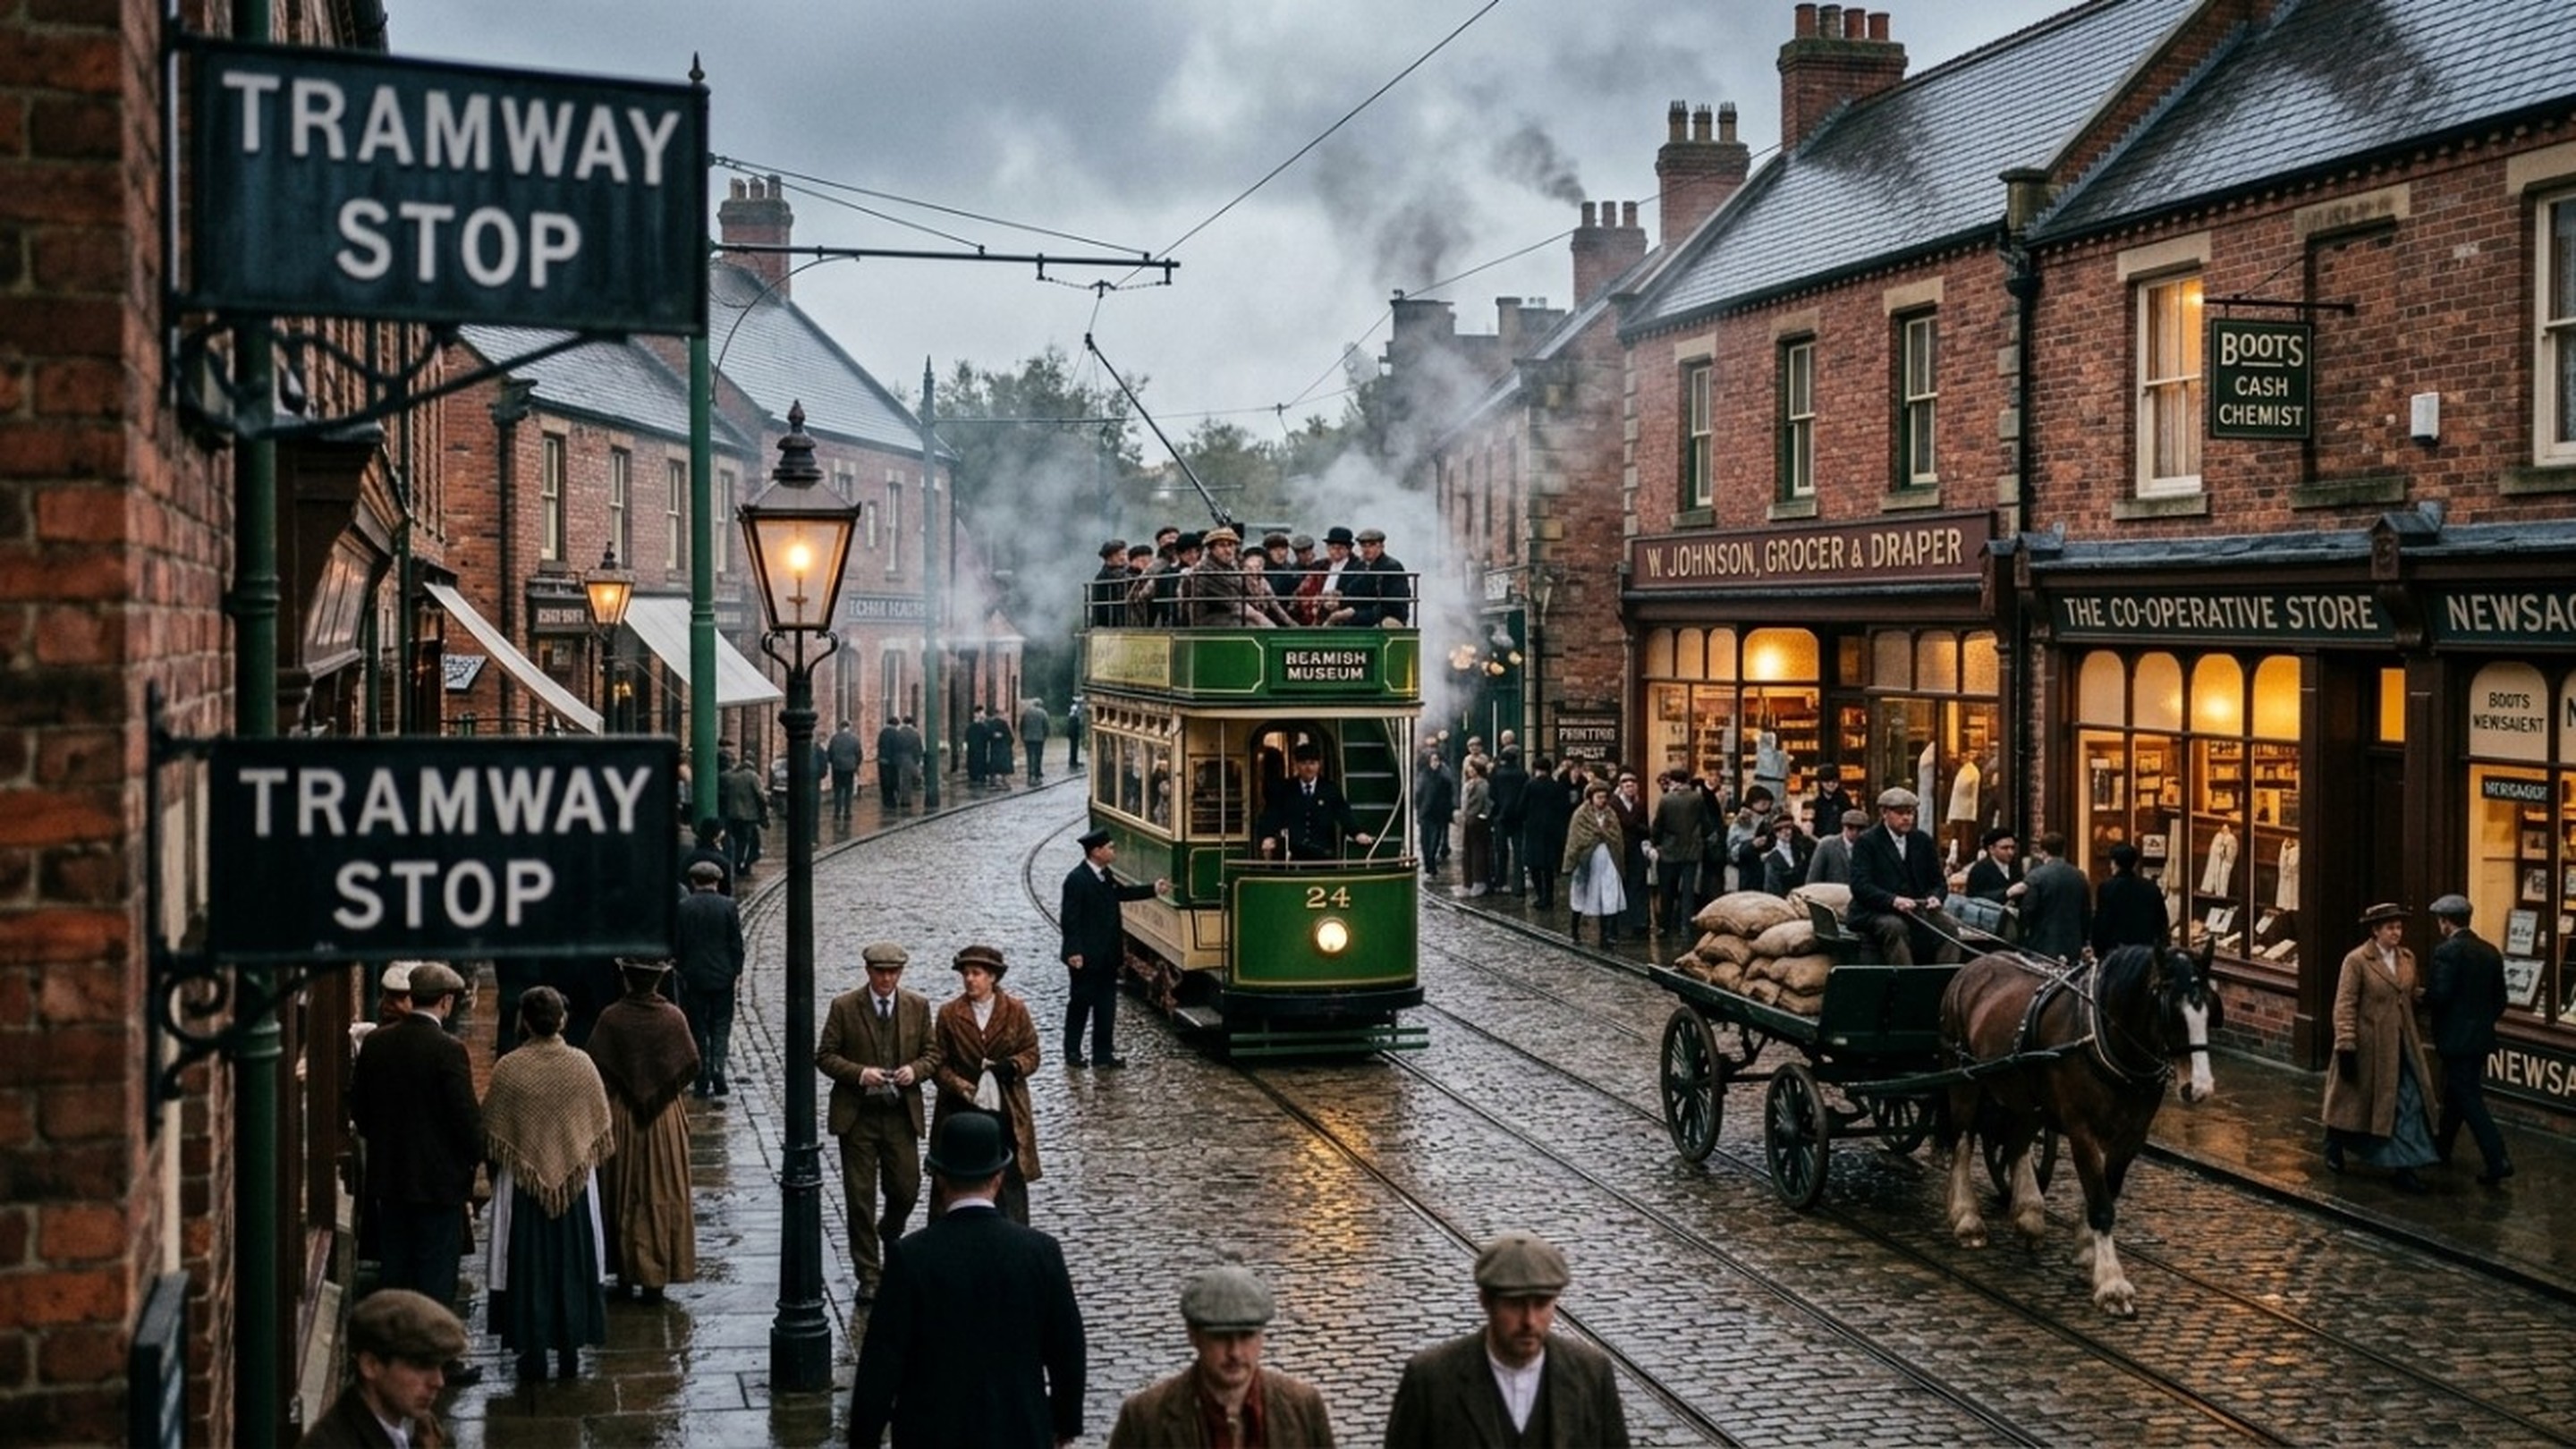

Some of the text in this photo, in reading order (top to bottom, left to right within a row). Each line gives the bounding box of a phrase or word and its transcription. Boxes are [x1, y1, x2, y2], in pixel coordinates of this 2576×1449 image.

[222, 72, 682, 187] TRAMWAY
[335, 198, 582, 290] STOP
[2221, 331, 2305, 368] BOOTS
[2235, 375, 2289, 398] CASH
[2219, 403, 2305, 428] CHEMIST
[1667, 541, 1761, 579] JOHNSON,
[1765, 535, 1844, 573] GROCER
[1851, 538, 1864, 566] &
[1871, 528, 1963, 568] DRAPER
[2063, 595, 2379, 631] THE CO-OPERATIVE STORE
[1285, 651, 1367, 665] BEAMISH
[1287, 666, 1364, 681] MUSEUM
[238, 766, 653, 837] TRAMWAY
[333, 860, 555, 931] STOP
[1306, 886, 1352, 909] 24
